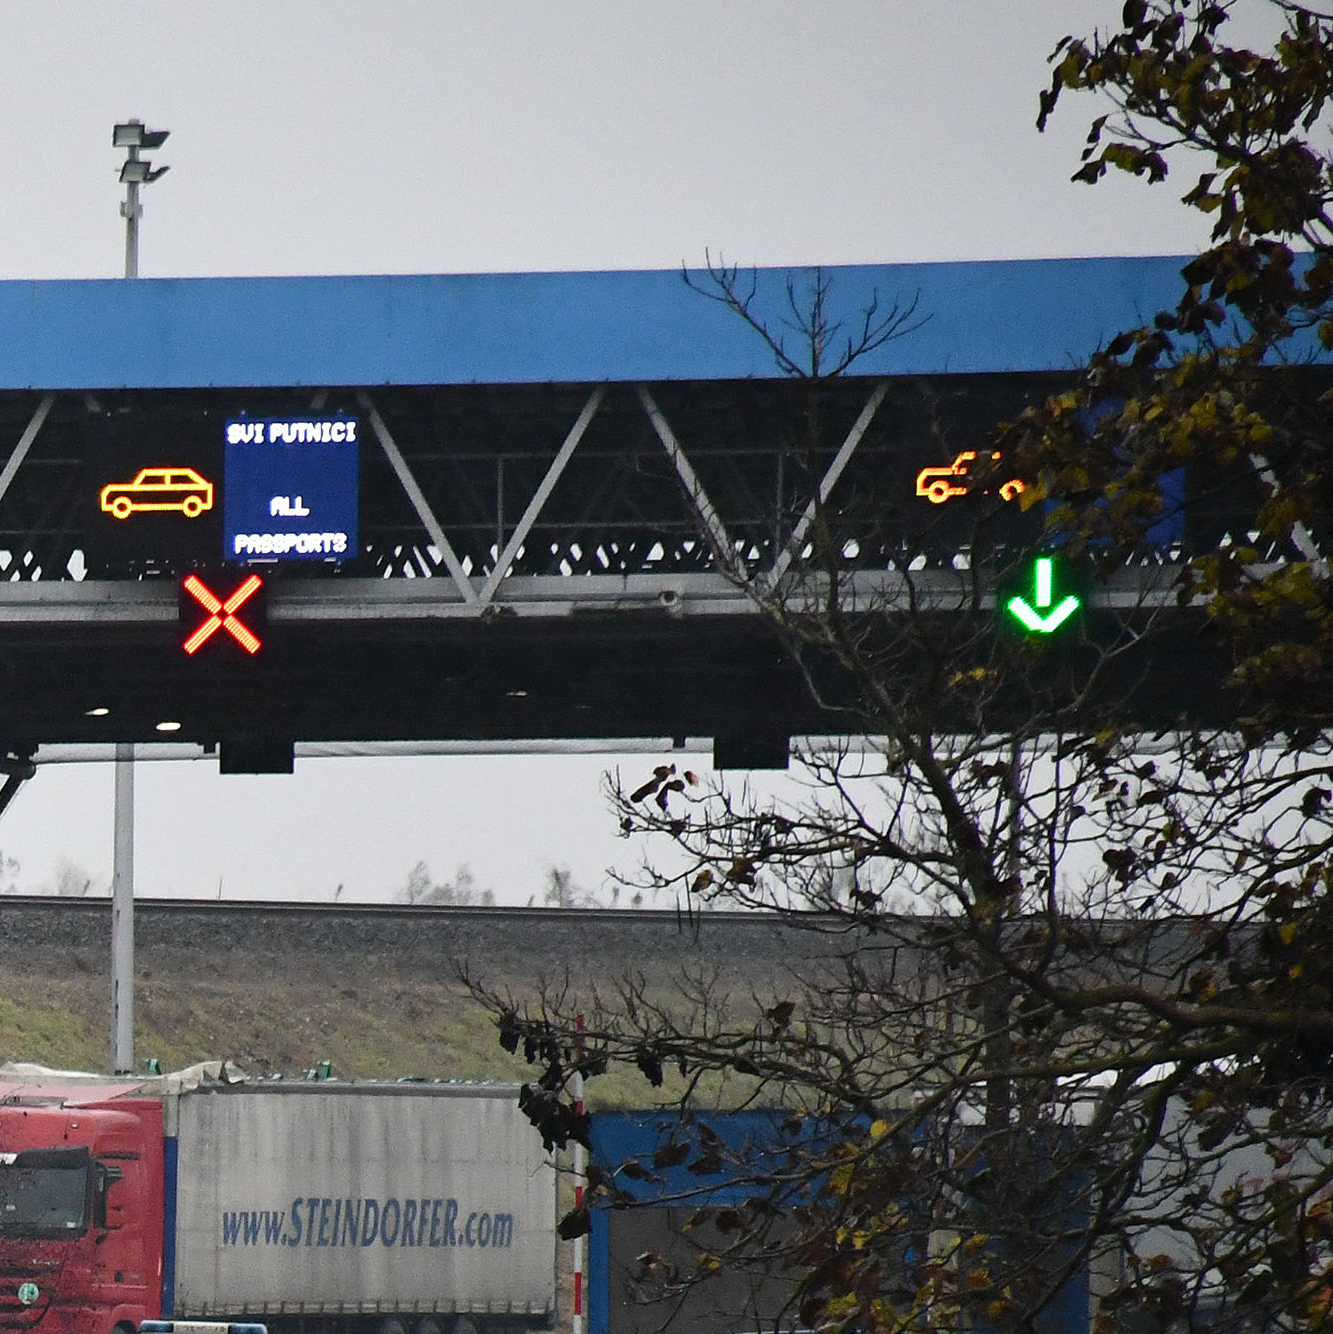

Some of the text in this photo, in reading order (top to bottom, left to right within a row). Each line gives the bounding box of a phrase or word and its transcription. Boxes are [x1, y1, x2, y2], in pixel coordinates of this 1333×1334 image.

[227, 422, 356, 444] SVI PUTNICI
[270, 496, 310, 516] ALL
[234, 533, 347, 554] PASSPORTS
[222, 1197, 513, 1248] www.STEINDORFER.com
